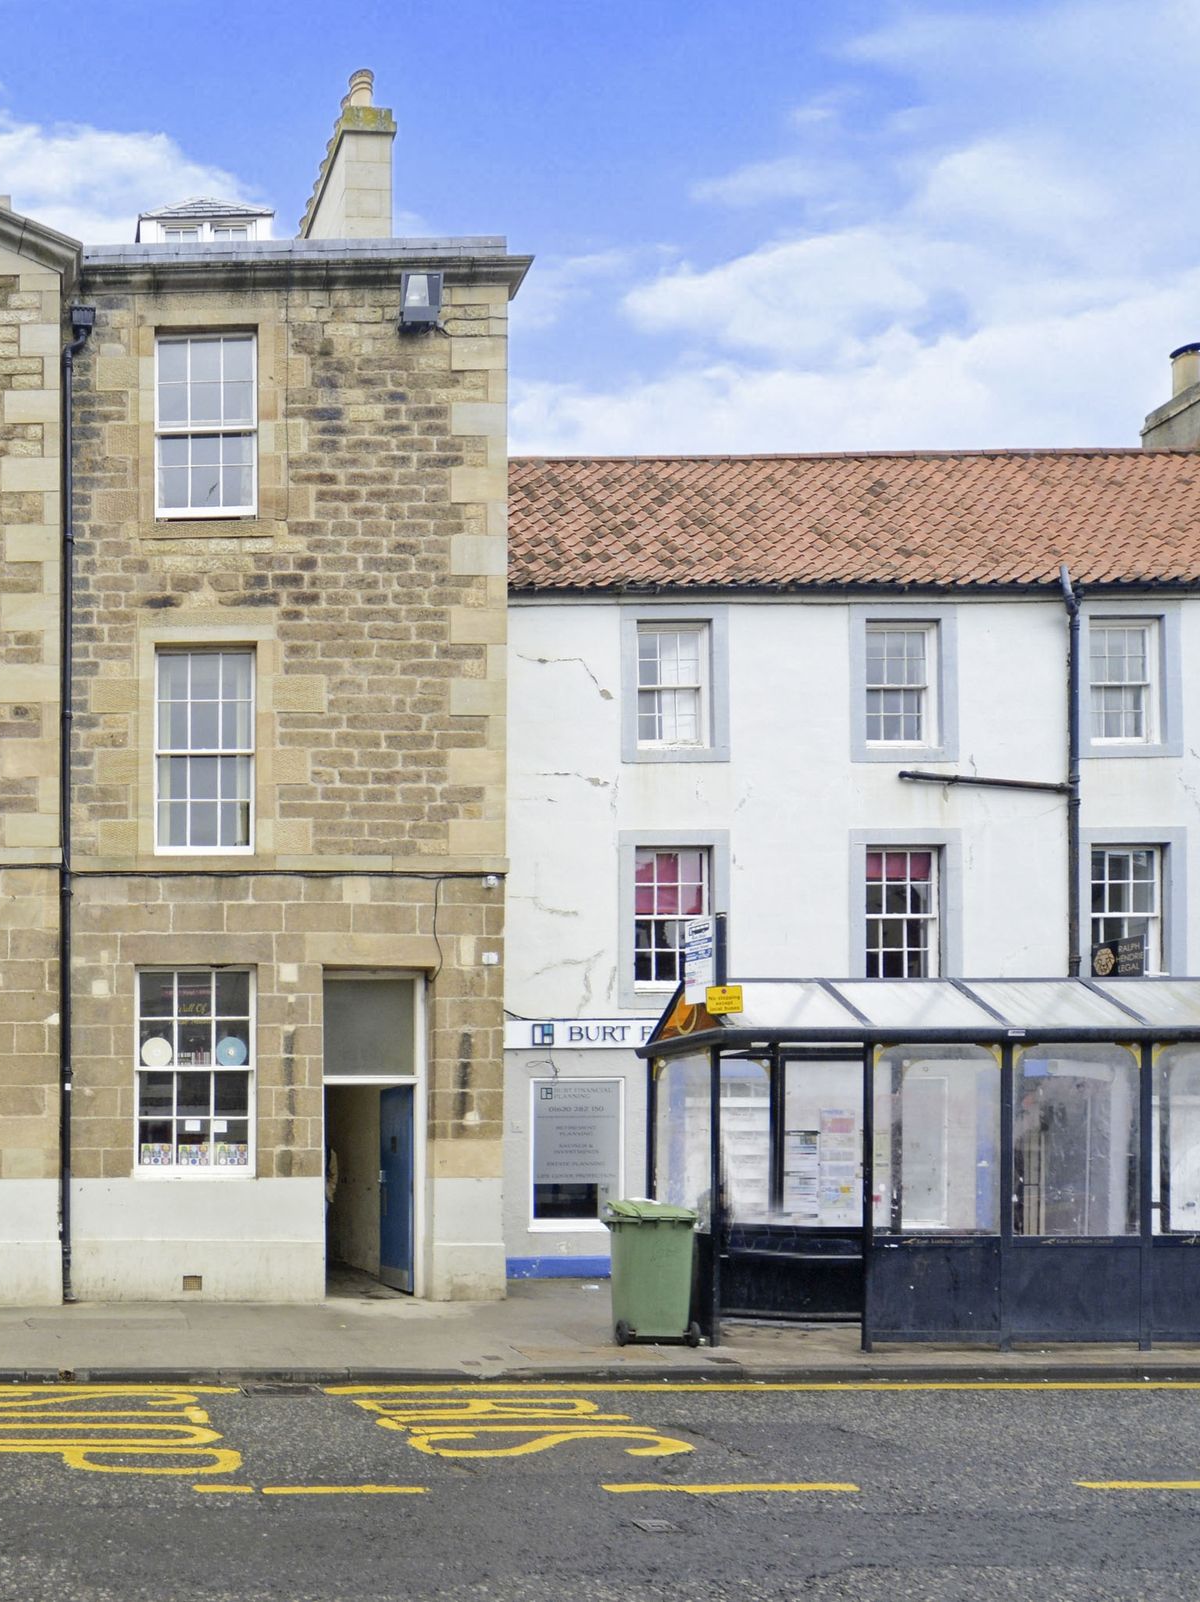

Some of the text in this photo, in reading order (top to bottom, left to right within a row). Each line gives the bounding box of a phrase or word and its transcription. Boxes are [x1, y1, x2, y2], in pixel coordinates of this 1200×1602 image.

[1118, 942, 1140, 953] RALPH
[1116, 951, 1144, 963] HENDRIE
[1117, 962, 1140, 973] LEGAL
[569, 1025, 631, 1042] BURT
[352, 1399, 696, 1458] BUS
